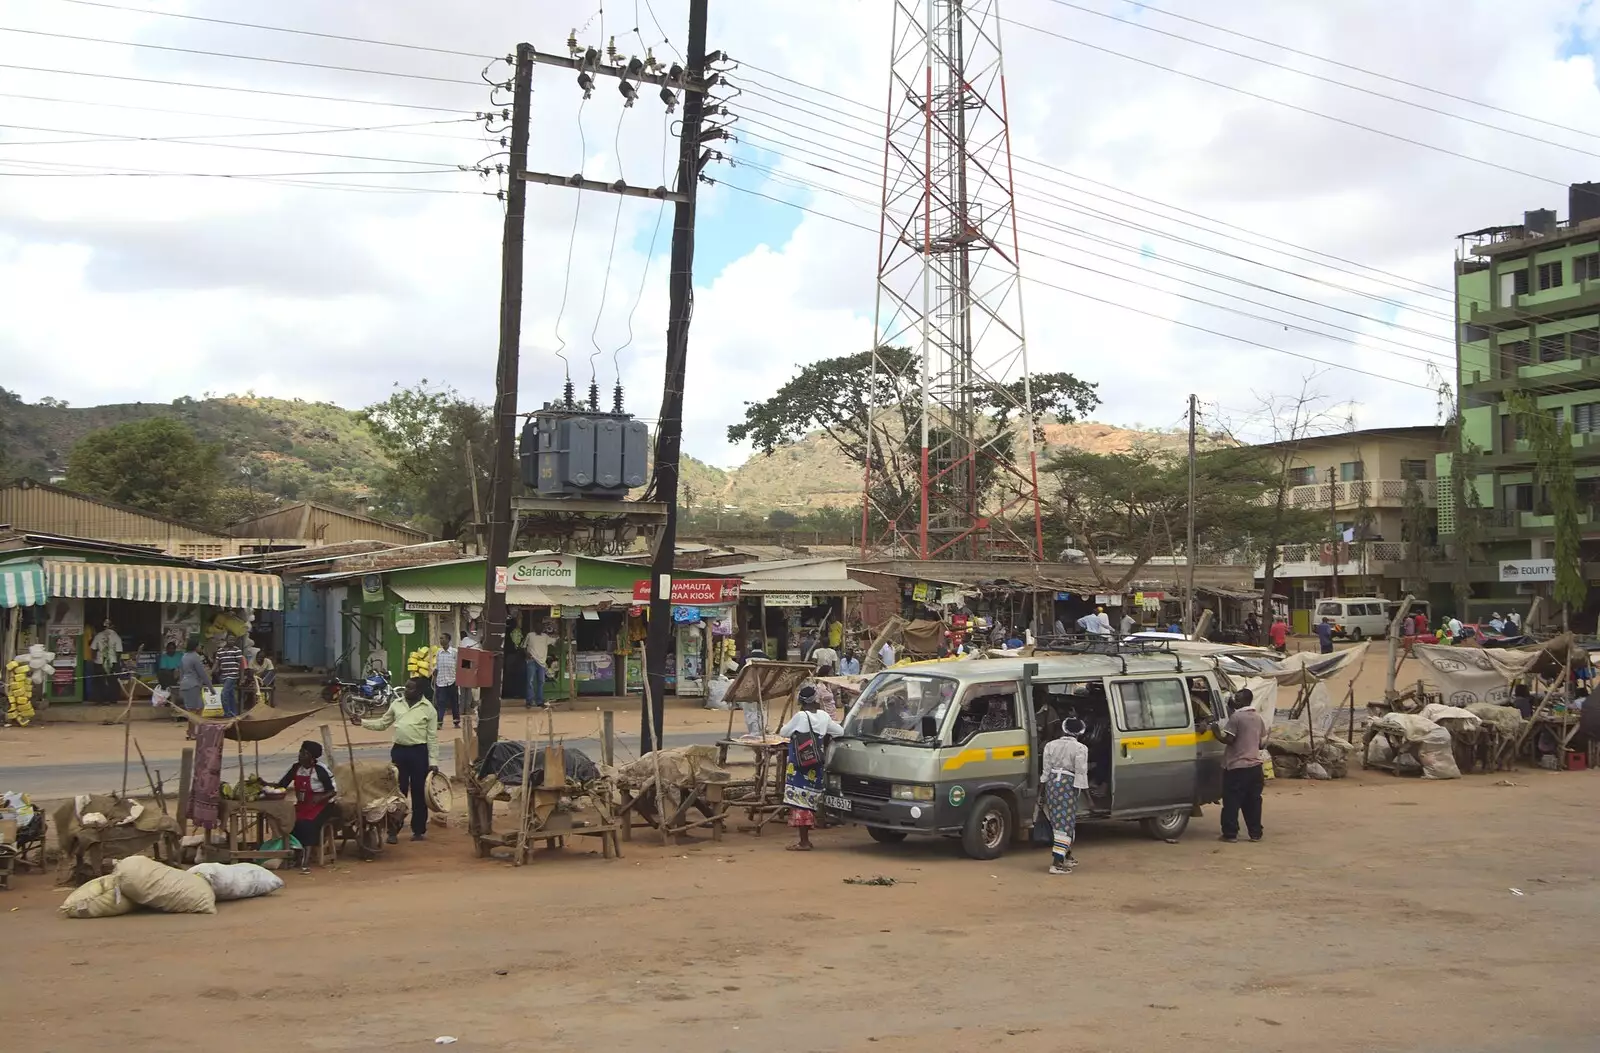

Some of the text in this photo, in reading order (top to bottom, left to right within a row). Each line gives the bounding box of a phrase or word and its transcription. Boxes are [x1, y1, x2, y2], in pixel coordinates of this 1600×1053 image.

[517, 565, 571, 577] Safaricom
[1521, 566, 1550, 575] EQUITY
[690, 592, 715, 600] KIOSK
